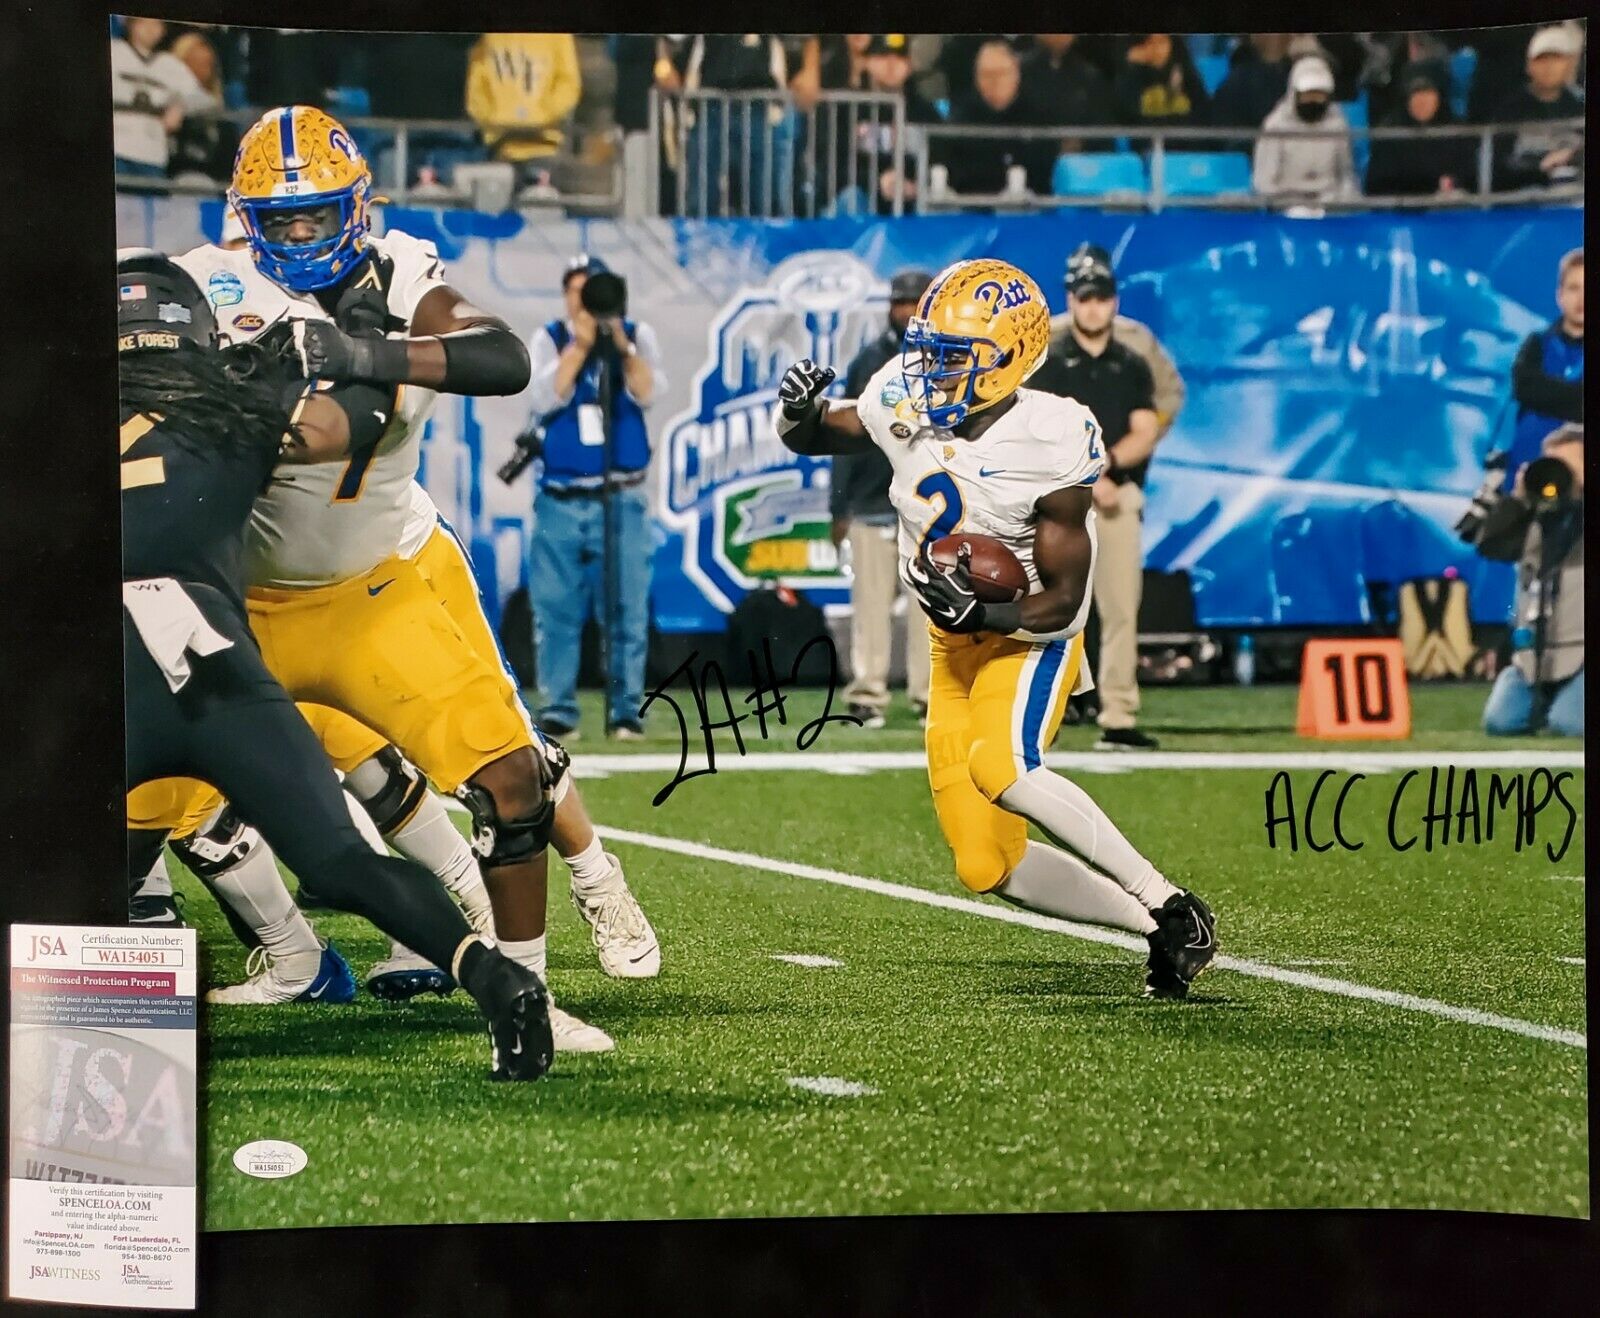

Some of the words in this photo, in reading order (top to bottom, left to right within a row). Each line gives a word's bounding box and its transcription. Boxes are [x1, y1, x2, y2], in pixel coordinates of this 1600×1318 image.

[973, 279, 1031, 315] Pitt
[138, 333, 180, 349] FOREST
[913, 467, 967, 556] 2
[1323, 653, 1393, 725] 10
[1265, 769, 1366, 852] ACC
[1388, 764, 1577, 863] CHAMPS
[81, 934, 140, 946] Certification
[141, 935, 183, 946] Number:
[28, 935, 68, 961] JSA
[98, 949, 166, 964] WA154051
[21, 973, 36, 983] The
[38, 973, 81, 985] Witnessed
[83, 976, 129, 987] Protection
[130, 978, 170, 990] Program
[82, 996, 100, 1004] which
[101, 998, 138, 1006] accompanies
[151, 998, 180, 1006] certificate
[93, 1006, 110, 1014] James
[110, 1007, 131, 1015] Spence
[132, 1008, 178, 1016] Authentication,
[77, 1015, 108, 1023] guaranteed
[49, 1186, 69, 1196] Verify
[70, 1187, 83, 1196] this
[84, 1188, 125, 1198] certification
[127, 1189, 136, 1199] by
[137, 1190, 164, 1200] visiting
[59, 1197, 151, 1211] SPENCELOA.COM
[51, 1209, 64, 1217] and
[65, 1211, 93, 1221] entering
[94, 1211, 106, 1220] the
[107, 1212, 159, 1222] alpha-numeric
[66, 1222, 85, 1230] value
[86, 1222, 118, 1231] indicated
[119, 1223, 141, 1232] above.
[34, 1230, 73, 1240] Parsippany,
[129, 1236, 171, 1244] Lauderdale,
[121, 1264, 141, 1277] JSA
